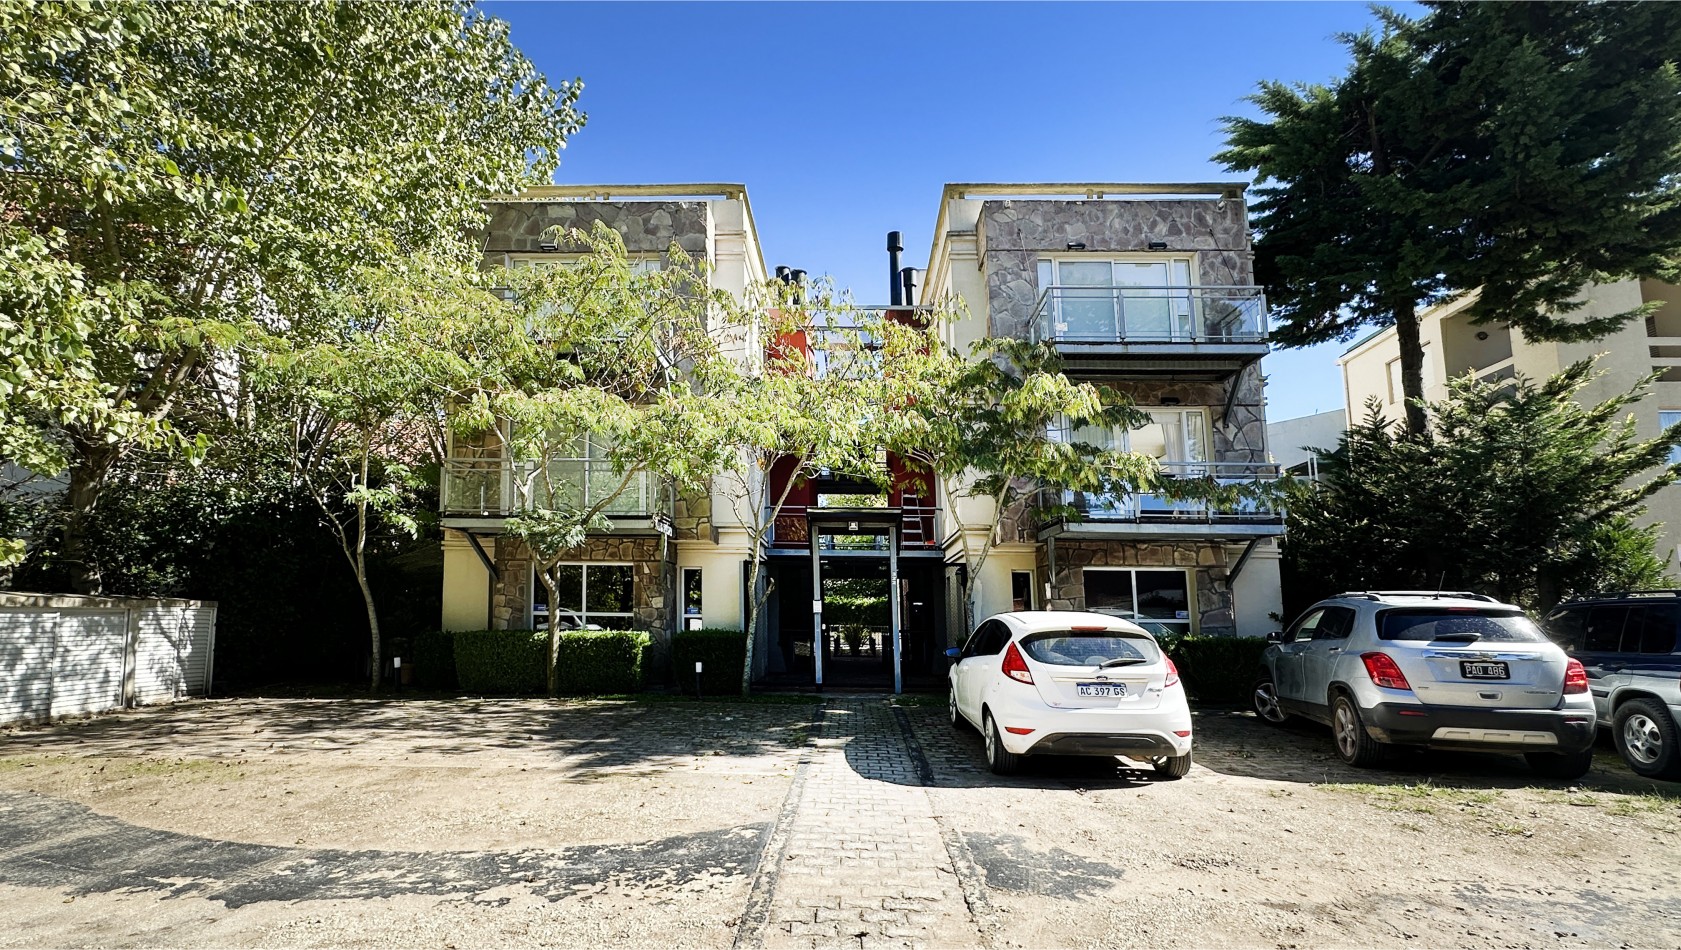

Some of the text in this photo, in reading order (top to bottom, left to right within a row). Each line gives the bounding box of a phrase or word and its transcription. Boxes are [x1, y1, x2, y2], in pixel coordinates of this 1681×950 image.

[1488, 666, 1505, 676] 486
[1080, 687, 1126, 696] AC 397 GS
